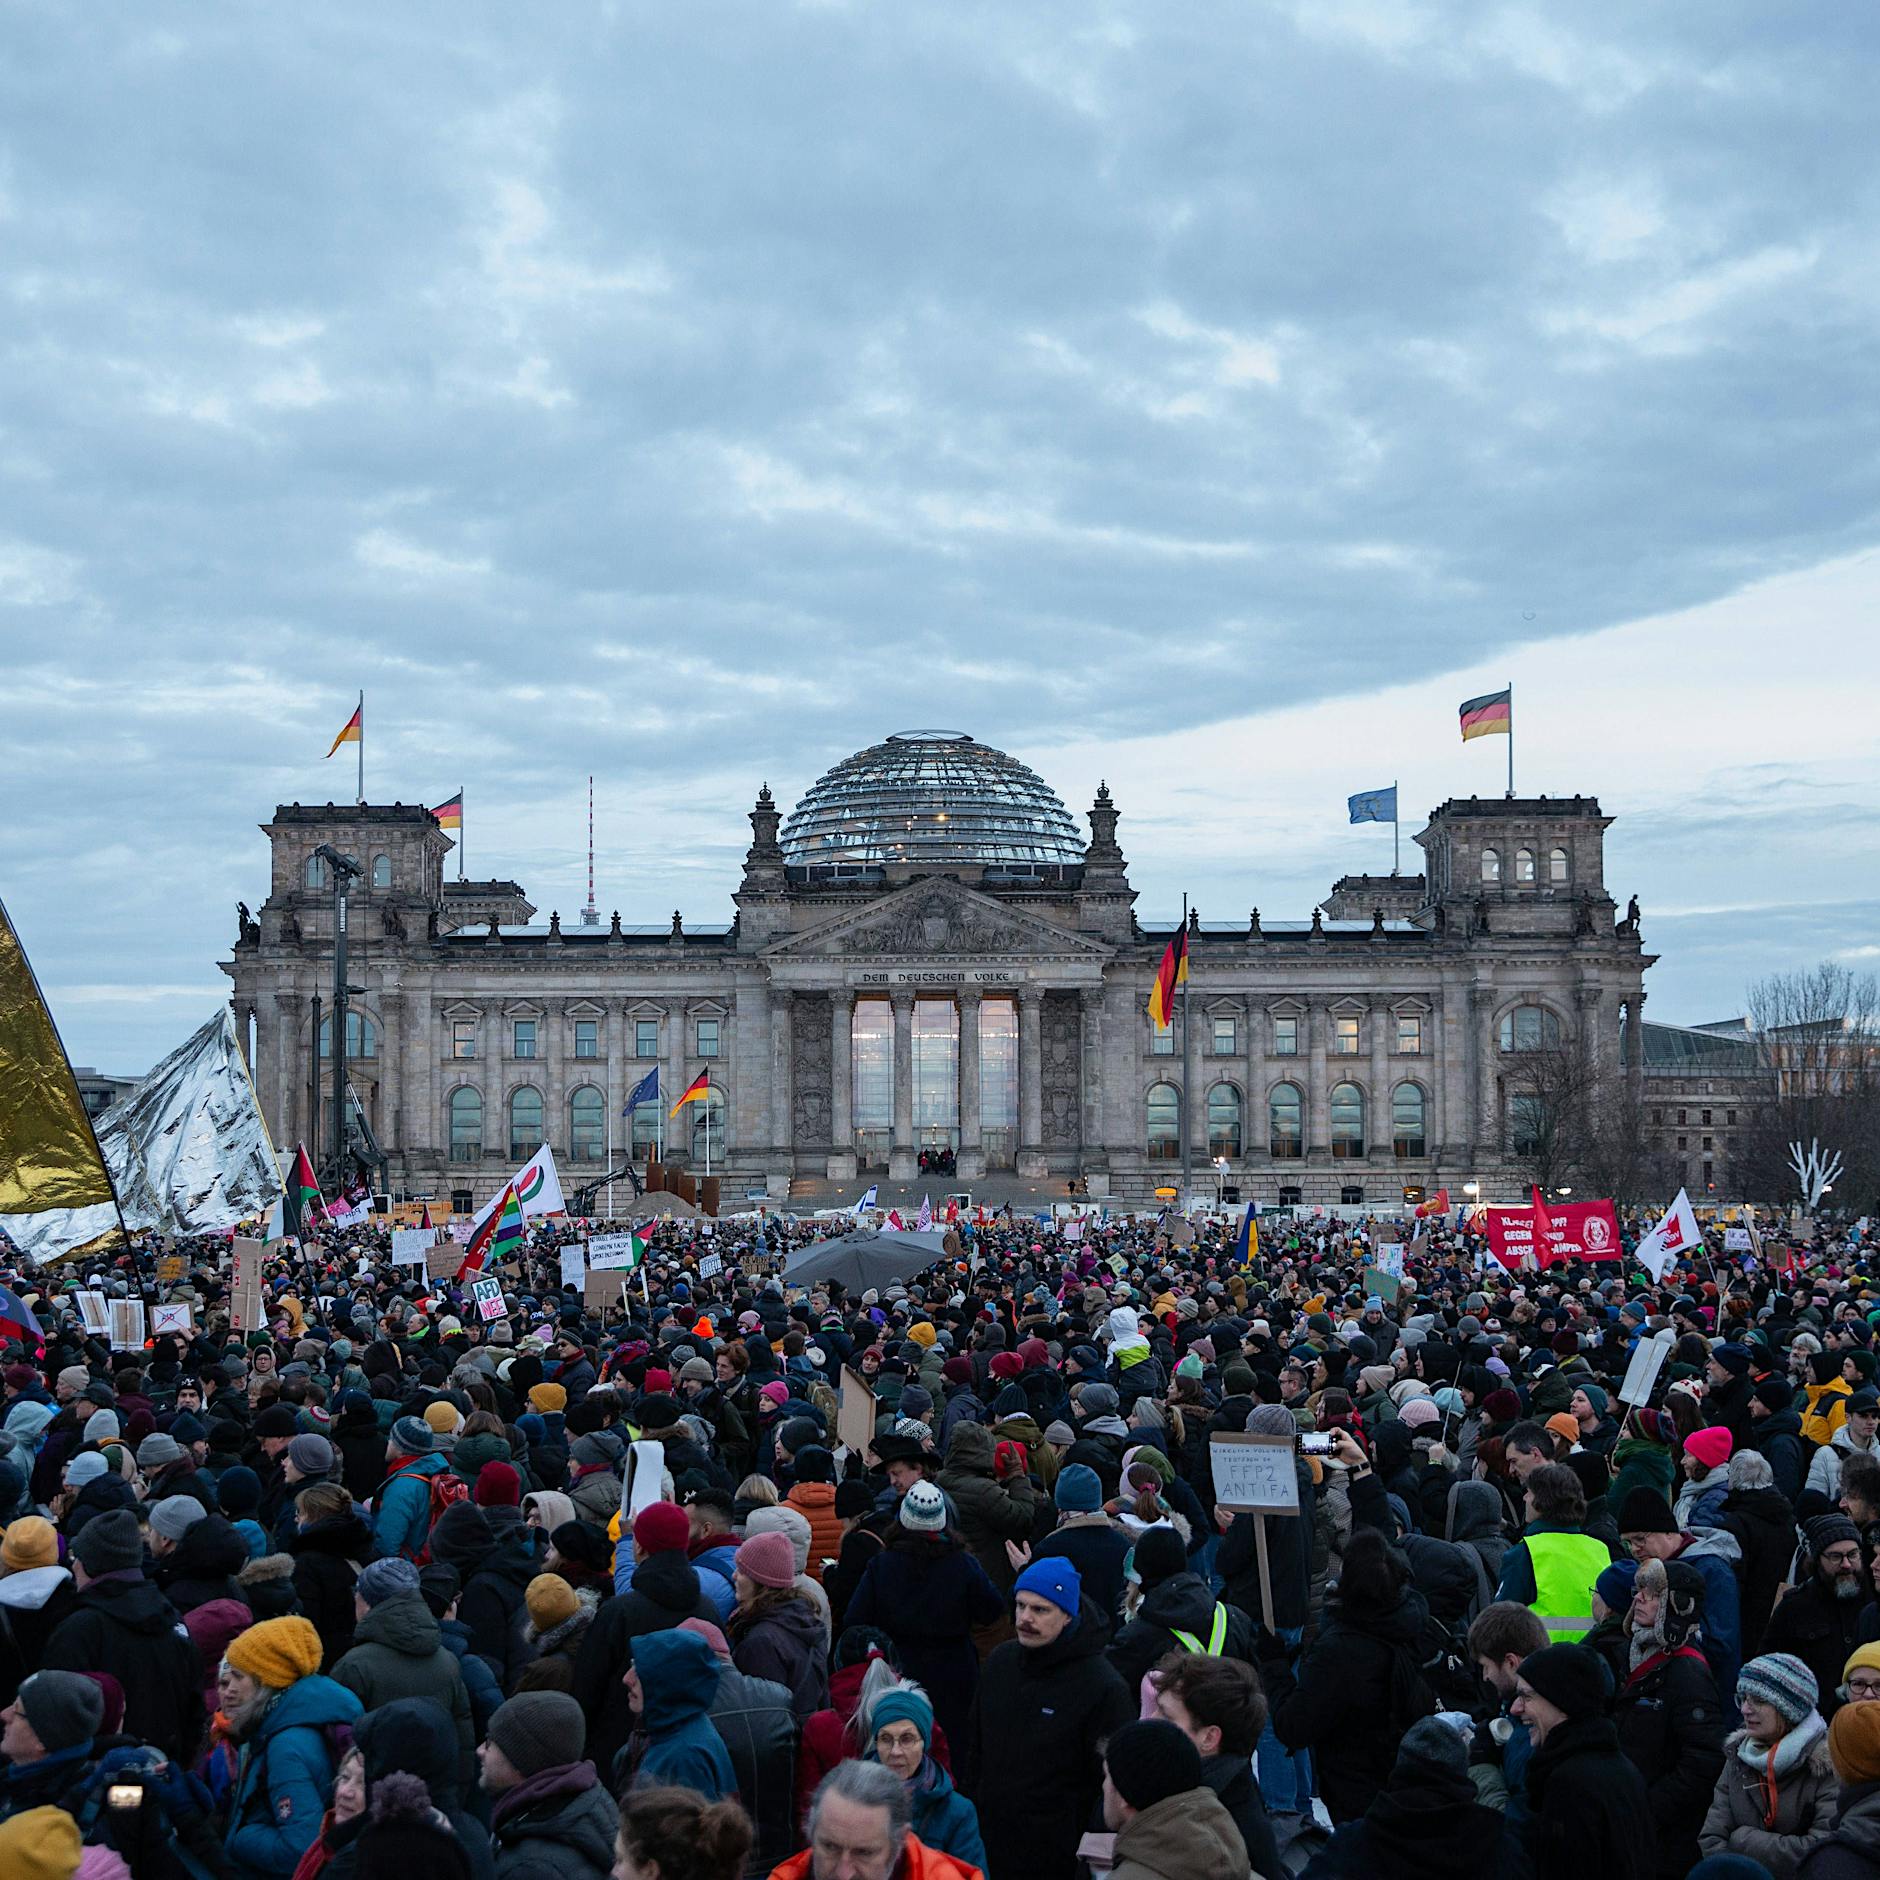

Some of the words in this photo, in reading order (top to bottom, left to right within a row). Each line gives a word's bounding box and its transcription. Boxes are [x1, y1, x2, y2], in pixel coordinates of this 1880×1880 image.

[863, 973, 889, 982] DEM
[898, 973, 965, 982] DEUTSCHEN
[974, 973, 1009, 982] VOLKE
[1503, 1230, 1532, 1241] GEGEN
[476, 1280, 500, 1301] AFD
[480, 1297, 506, 1320] NEE
[1230, 1465, 1277, 1482] FFP2
[1222, 1482, 1289, 1497] ANTIFA
